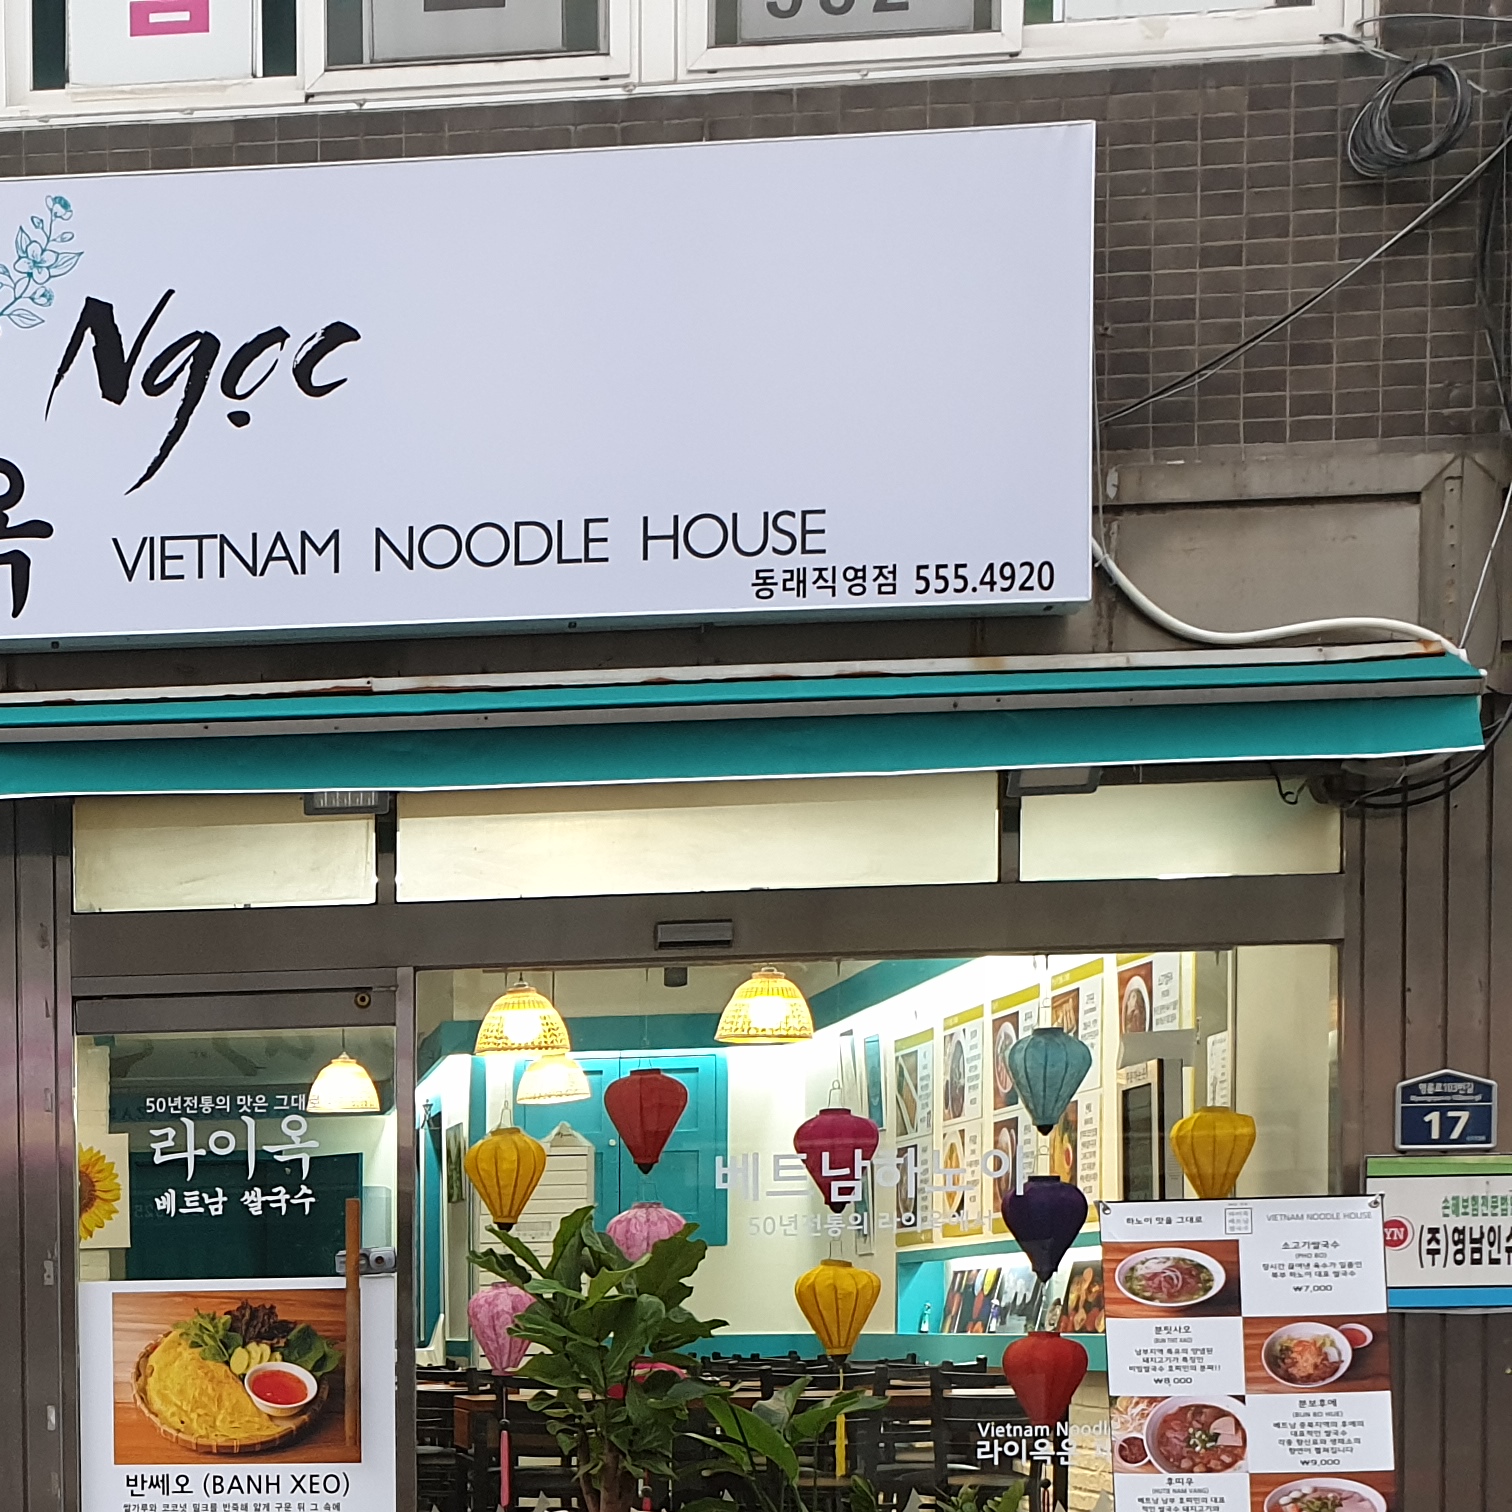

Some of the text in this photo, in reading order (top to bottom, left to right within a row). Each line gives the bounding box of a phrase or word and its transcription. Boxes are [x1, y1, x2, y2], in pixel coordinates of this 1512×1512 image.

[44, 288, 364, 496] Ngọc
[111, 508, 828, 583] VIETNAM NOODLE HOUSE
[750, 559, 1056, 600] 동래직영점 555.4920
[145, 1095, 231, 1114] 50년전통의
[236, 1094, 269, 1113] 맛은
[1423, 1110, 1470, 1140] 17
[148, 1114, 320, 1182] 라이옥
[154, 1184, 317, 1218] 베트남 쌀국수
[1266, 1211, 1372, 1222] VIETNAM NOODLE HOUSE
[1281, 1240, 1340, 1250] 소고기쌀국수
[1292, 1285, 1333, 1293] ₩7,000
[977, 1421, 1112, 1438] Vietnam Noodl
[1300, 1458, 1341, 1467] ₩9,000
[125, 1471, 351, 1497] 반쎄오 (BANH XEO)
[310, 1502, 318, 1512] 그
